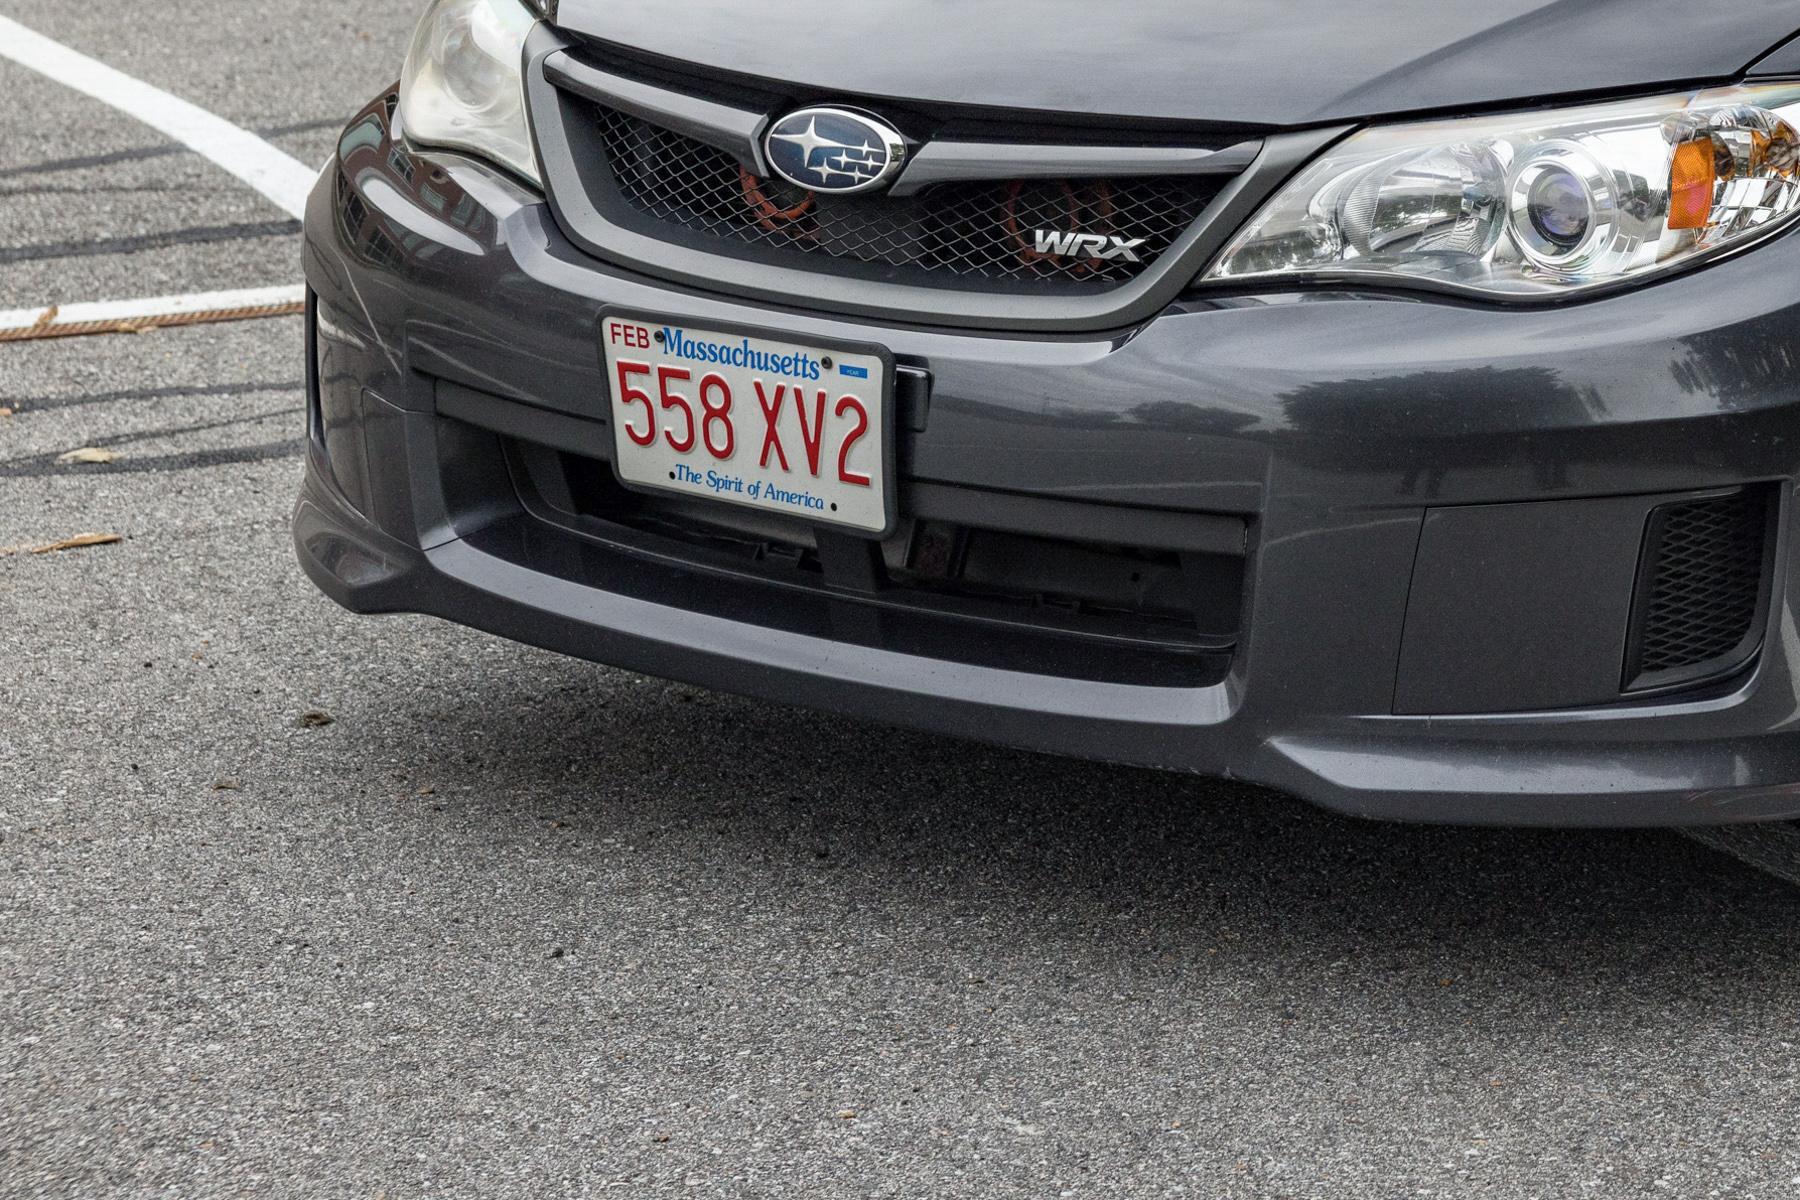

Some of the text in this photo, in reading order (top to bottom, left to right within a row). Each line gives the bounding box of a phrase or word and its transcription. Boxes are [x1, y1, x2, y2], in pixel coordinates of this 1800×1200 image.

[1035, 229, 1147, 262] WRX
[610, 323, 650, 349] FEB
[662, 327, 820, 380] Massachusetts
[616, 360, 871, 487] 558 XV2
[675, 464, 824, 511] The Spirit of America
